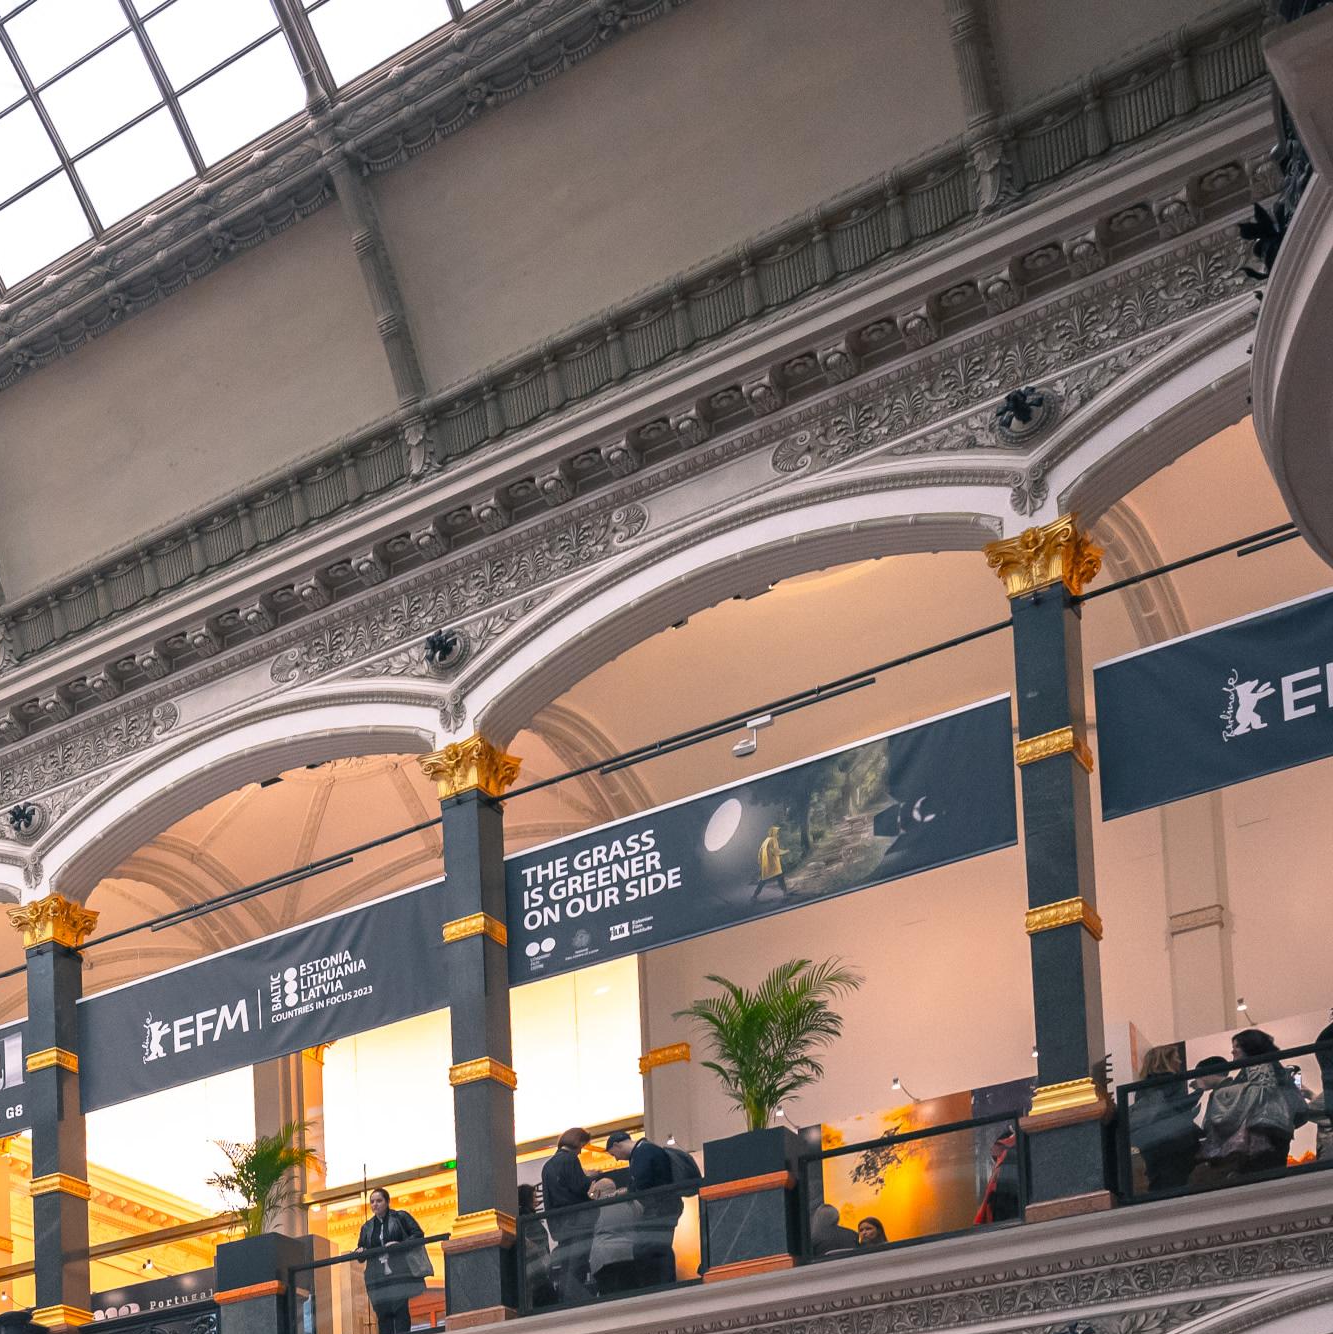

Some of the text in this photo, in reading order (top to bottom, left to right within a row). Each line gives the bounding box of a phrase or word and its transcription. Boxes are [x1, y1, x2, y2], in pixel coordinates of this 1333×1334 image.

[521, 829, 656, 887] THE GRASS
[523, 851, 662, 910] IS GREENER
[523, 866, 681, 931] ON OUR SIDE
[299, 949, 352, 977] ESTONIA
[300, 958, 367, 990] LITHUANIA
[270, 971, 283, 1012] BALTIC
[271, 985, 373, 1023] COUNTRIES IN FOCUS 2023
[301, 979, 344, 1003] LATVIA
[173, 998, 250, 1053] EFM
[5, 1104, 25, 1119] G8
[150, 1288, 213, 1310] Portugal
